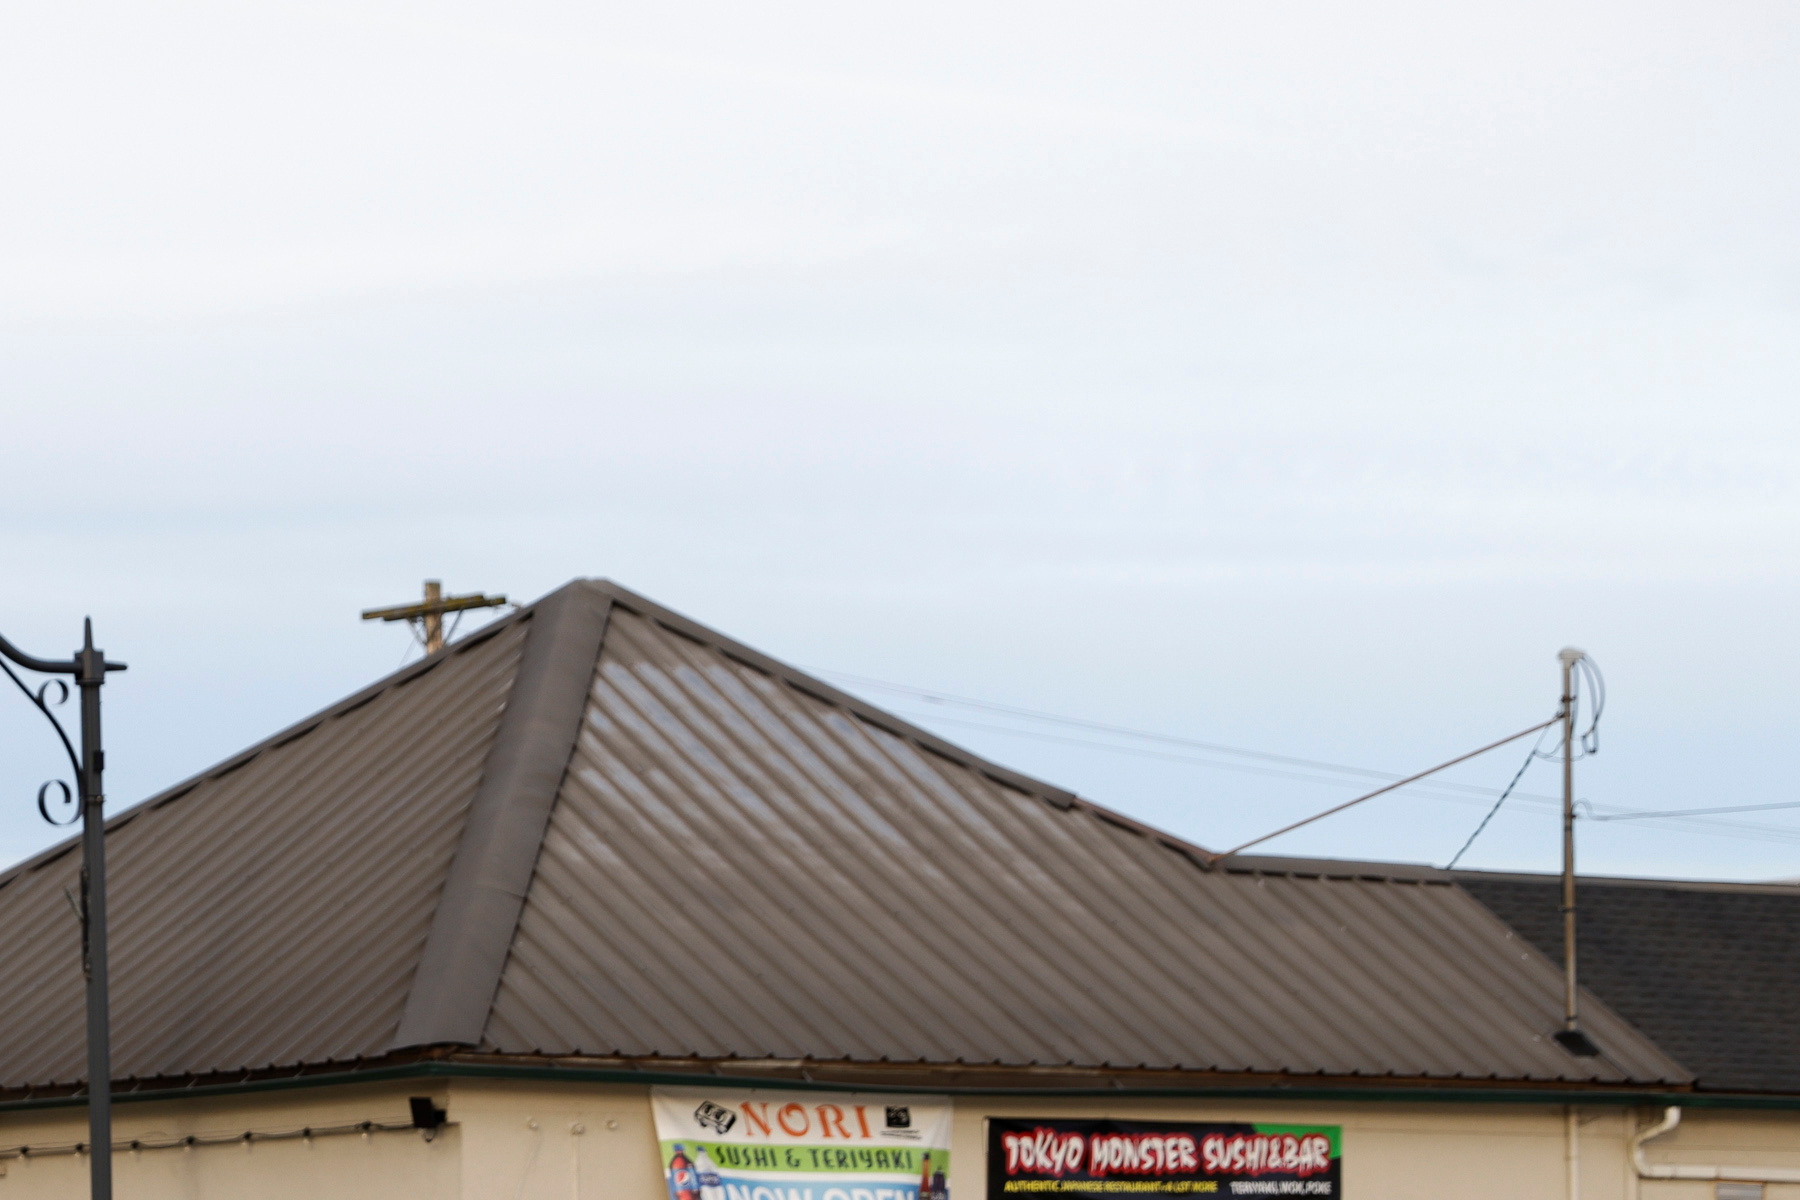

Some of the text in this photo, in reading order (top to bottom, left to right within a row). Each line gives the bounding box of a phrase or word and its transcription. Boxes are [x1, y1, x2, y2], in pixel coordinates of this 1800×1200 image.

[739, 1101, 873, 1140] NORI
[715, 1145, 913, 1170] SUSHI & TERIYAKI
[1003, 1128, 1085, 1176] TOKYO
[1090, 1133, 1198, 1175] MONSTER
[1004, 1180, 1061, 1193] AUTHENTIC
